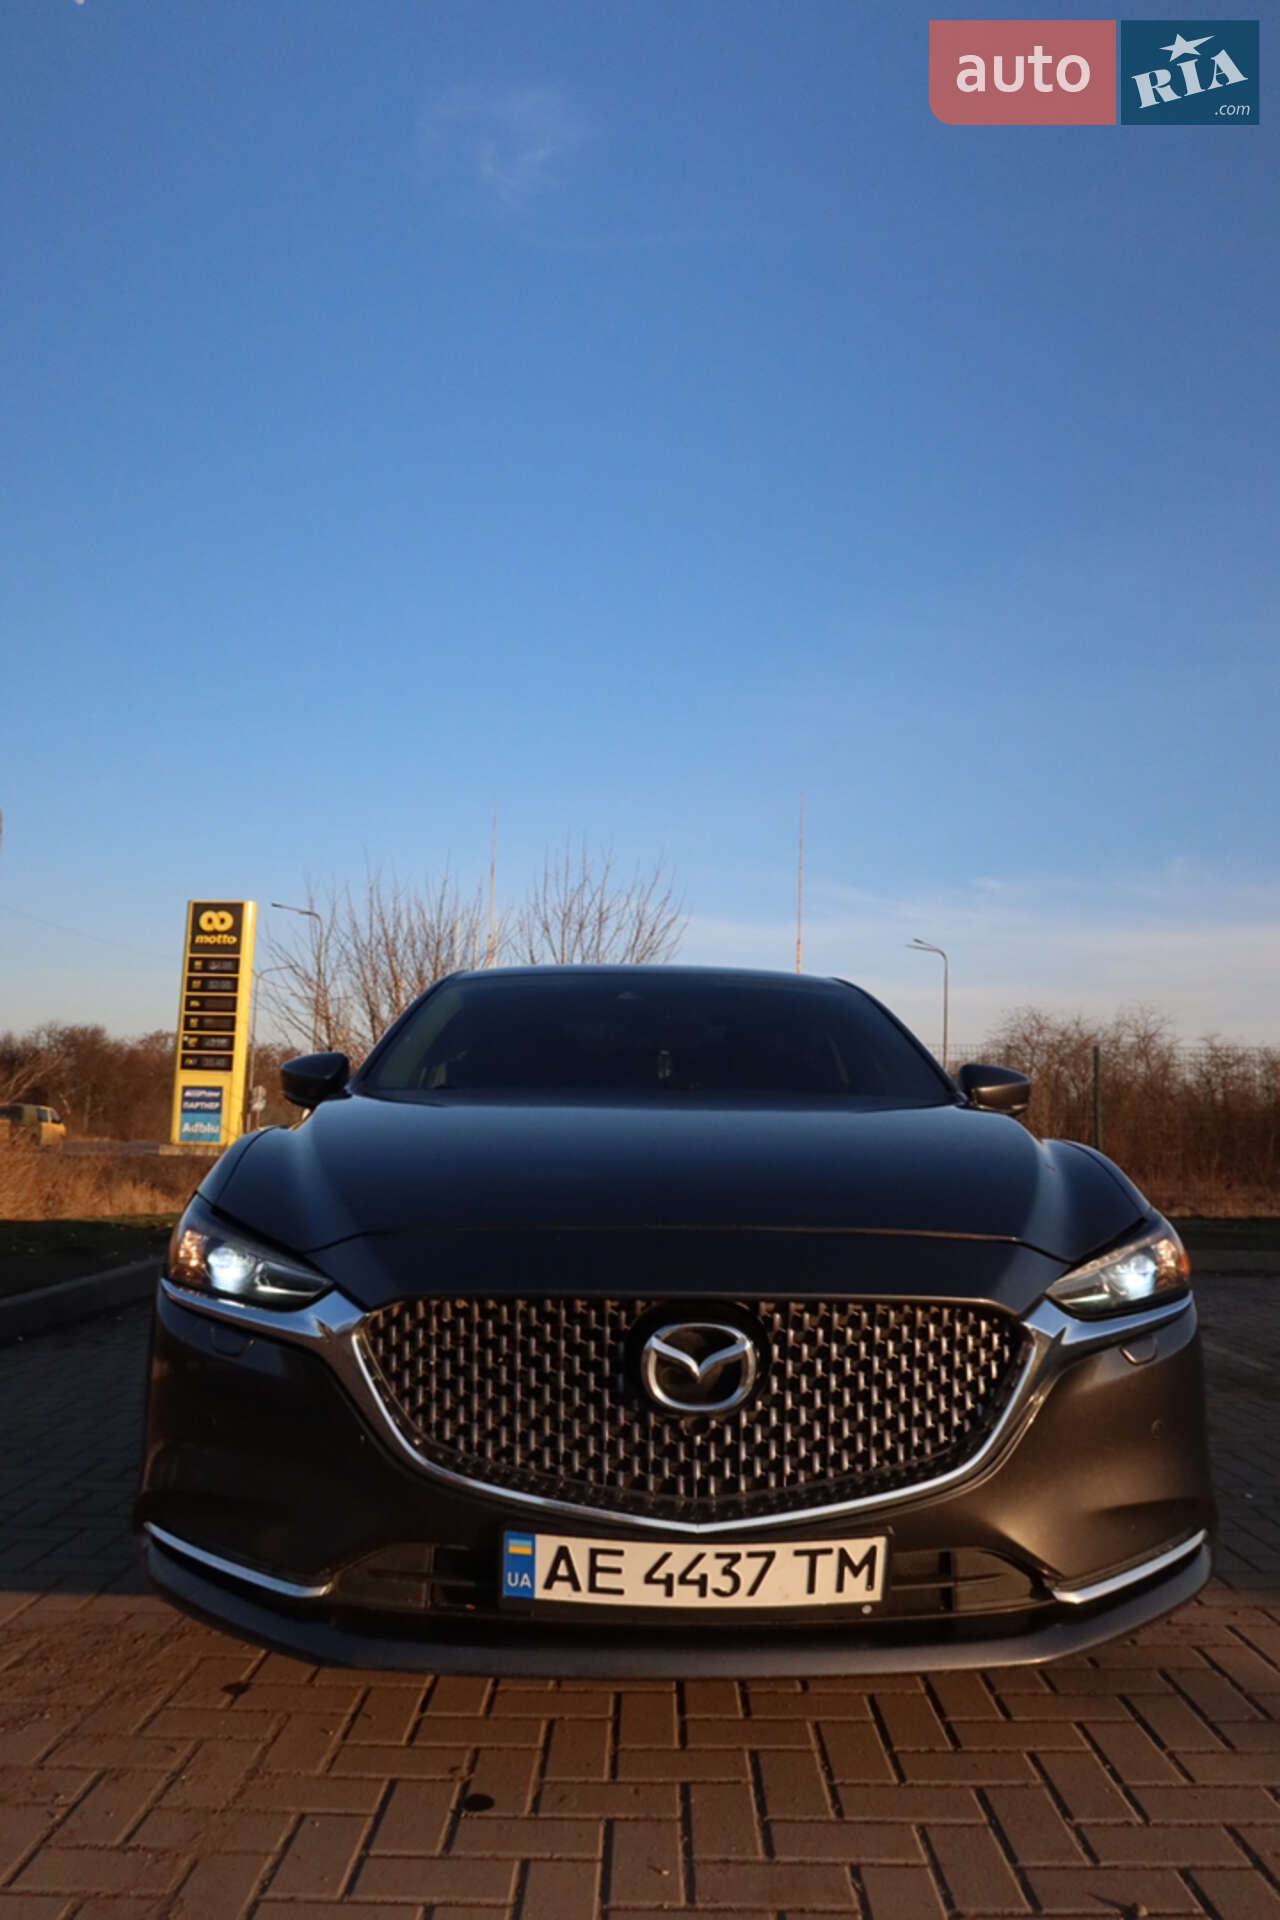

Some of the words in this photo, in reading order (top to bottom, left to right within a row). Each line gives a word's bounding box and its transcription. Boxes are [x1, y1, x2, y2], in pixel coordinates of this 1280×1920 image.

[195, 934, 237, 945] motto
[542, 1544, 625, 1596] AE
[643, 1551, 776, 1598] 4437
[793, 1544, 877, 1594] TM
[507, 1572, 532, 1588] UA
